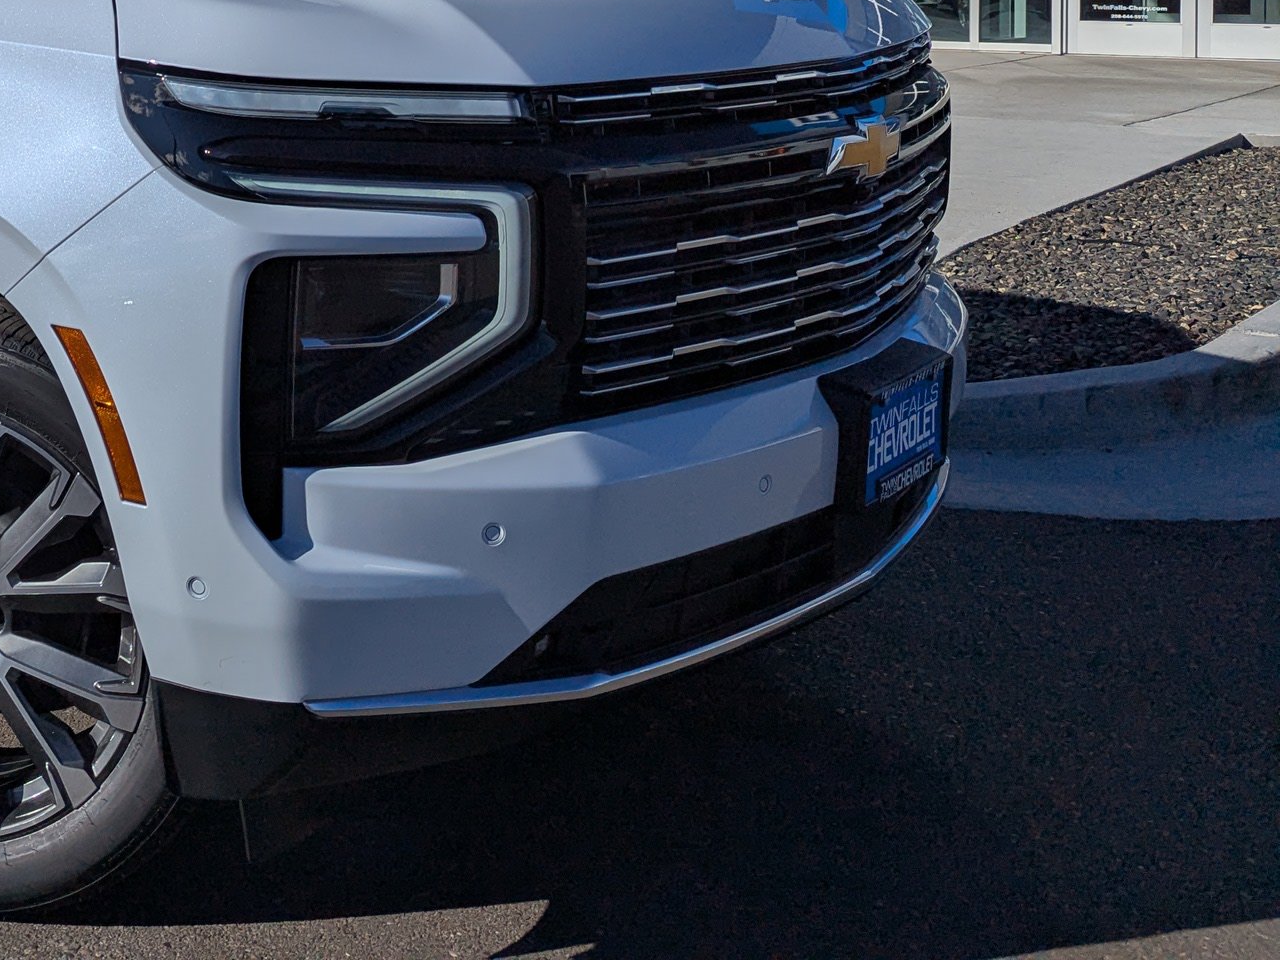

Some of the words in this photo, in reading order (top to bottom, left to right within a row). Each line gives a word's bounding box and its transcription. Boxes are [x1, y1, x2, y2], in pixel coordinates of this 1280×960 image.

[867, 401, 938, 475] CHEVROLET
[870, 382, 939, 440] TWINFALLS
[896, 453, 934, 492] CHEVROLET
